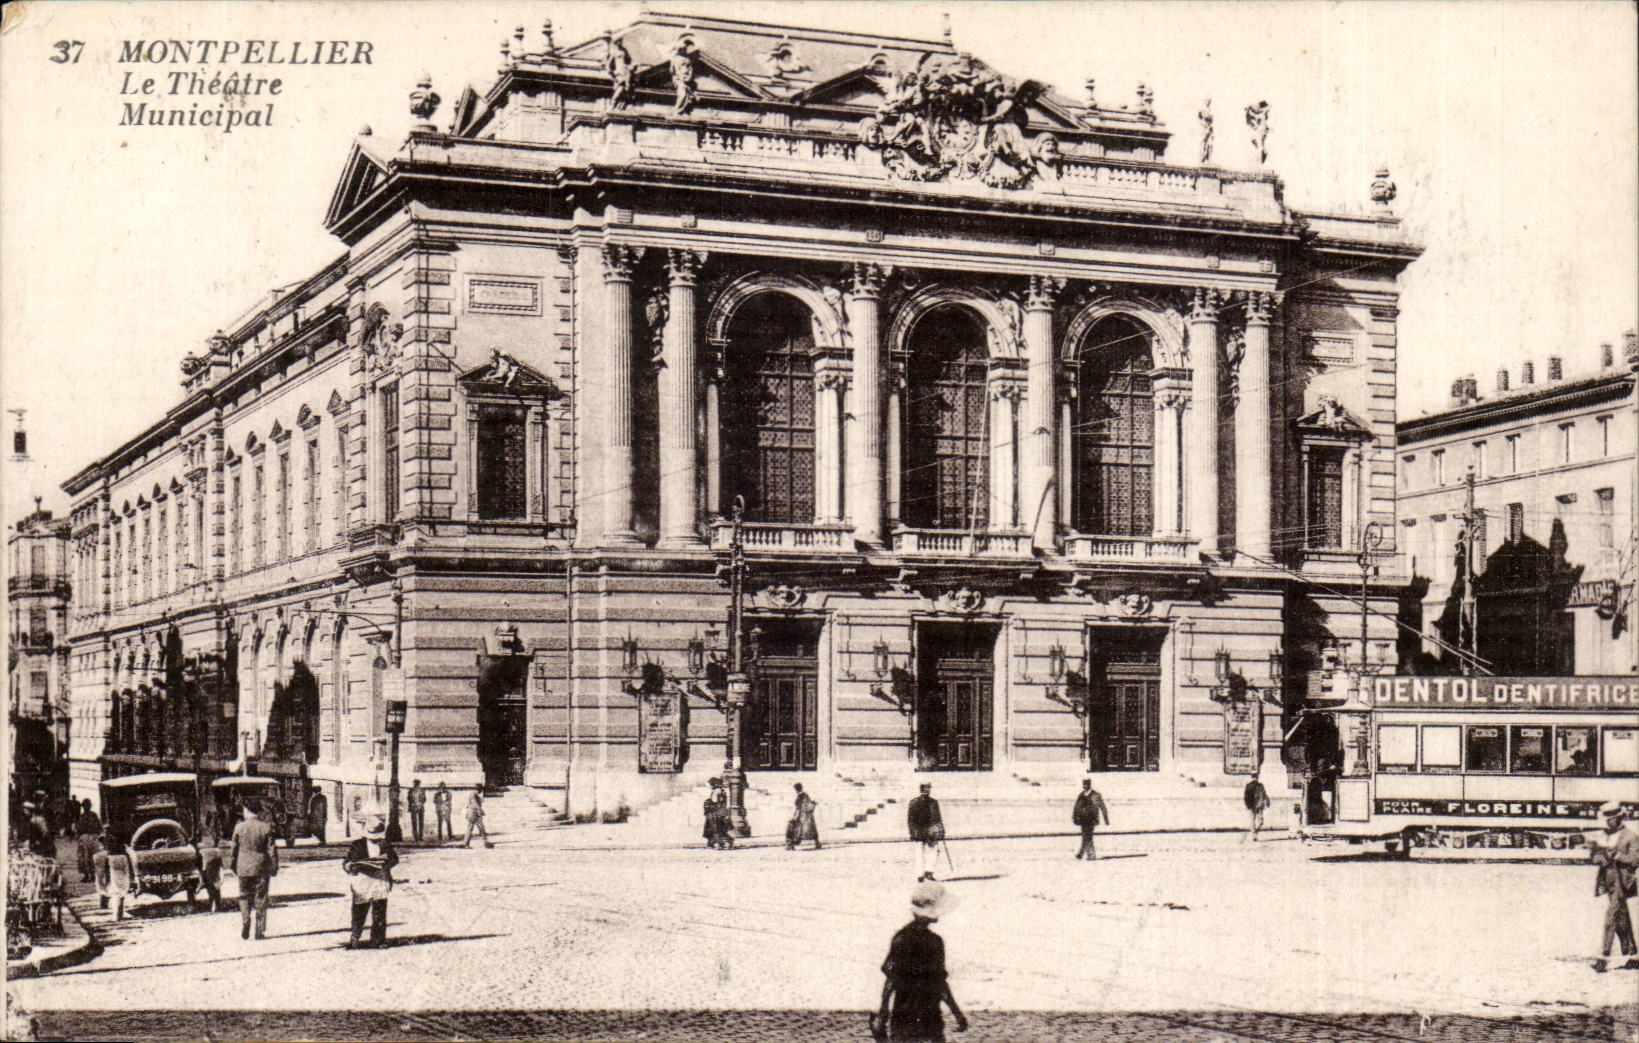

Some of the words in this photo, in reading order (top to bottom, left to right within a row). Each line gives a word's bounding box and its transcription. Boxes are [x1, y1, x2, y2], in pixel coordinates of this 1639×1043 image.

[1375, 678, 1487, 702] DENTOL
[1494, 684, 1639, 702] DENTIFRICE
[1447, 802, 1569, 814] FLOREINE
